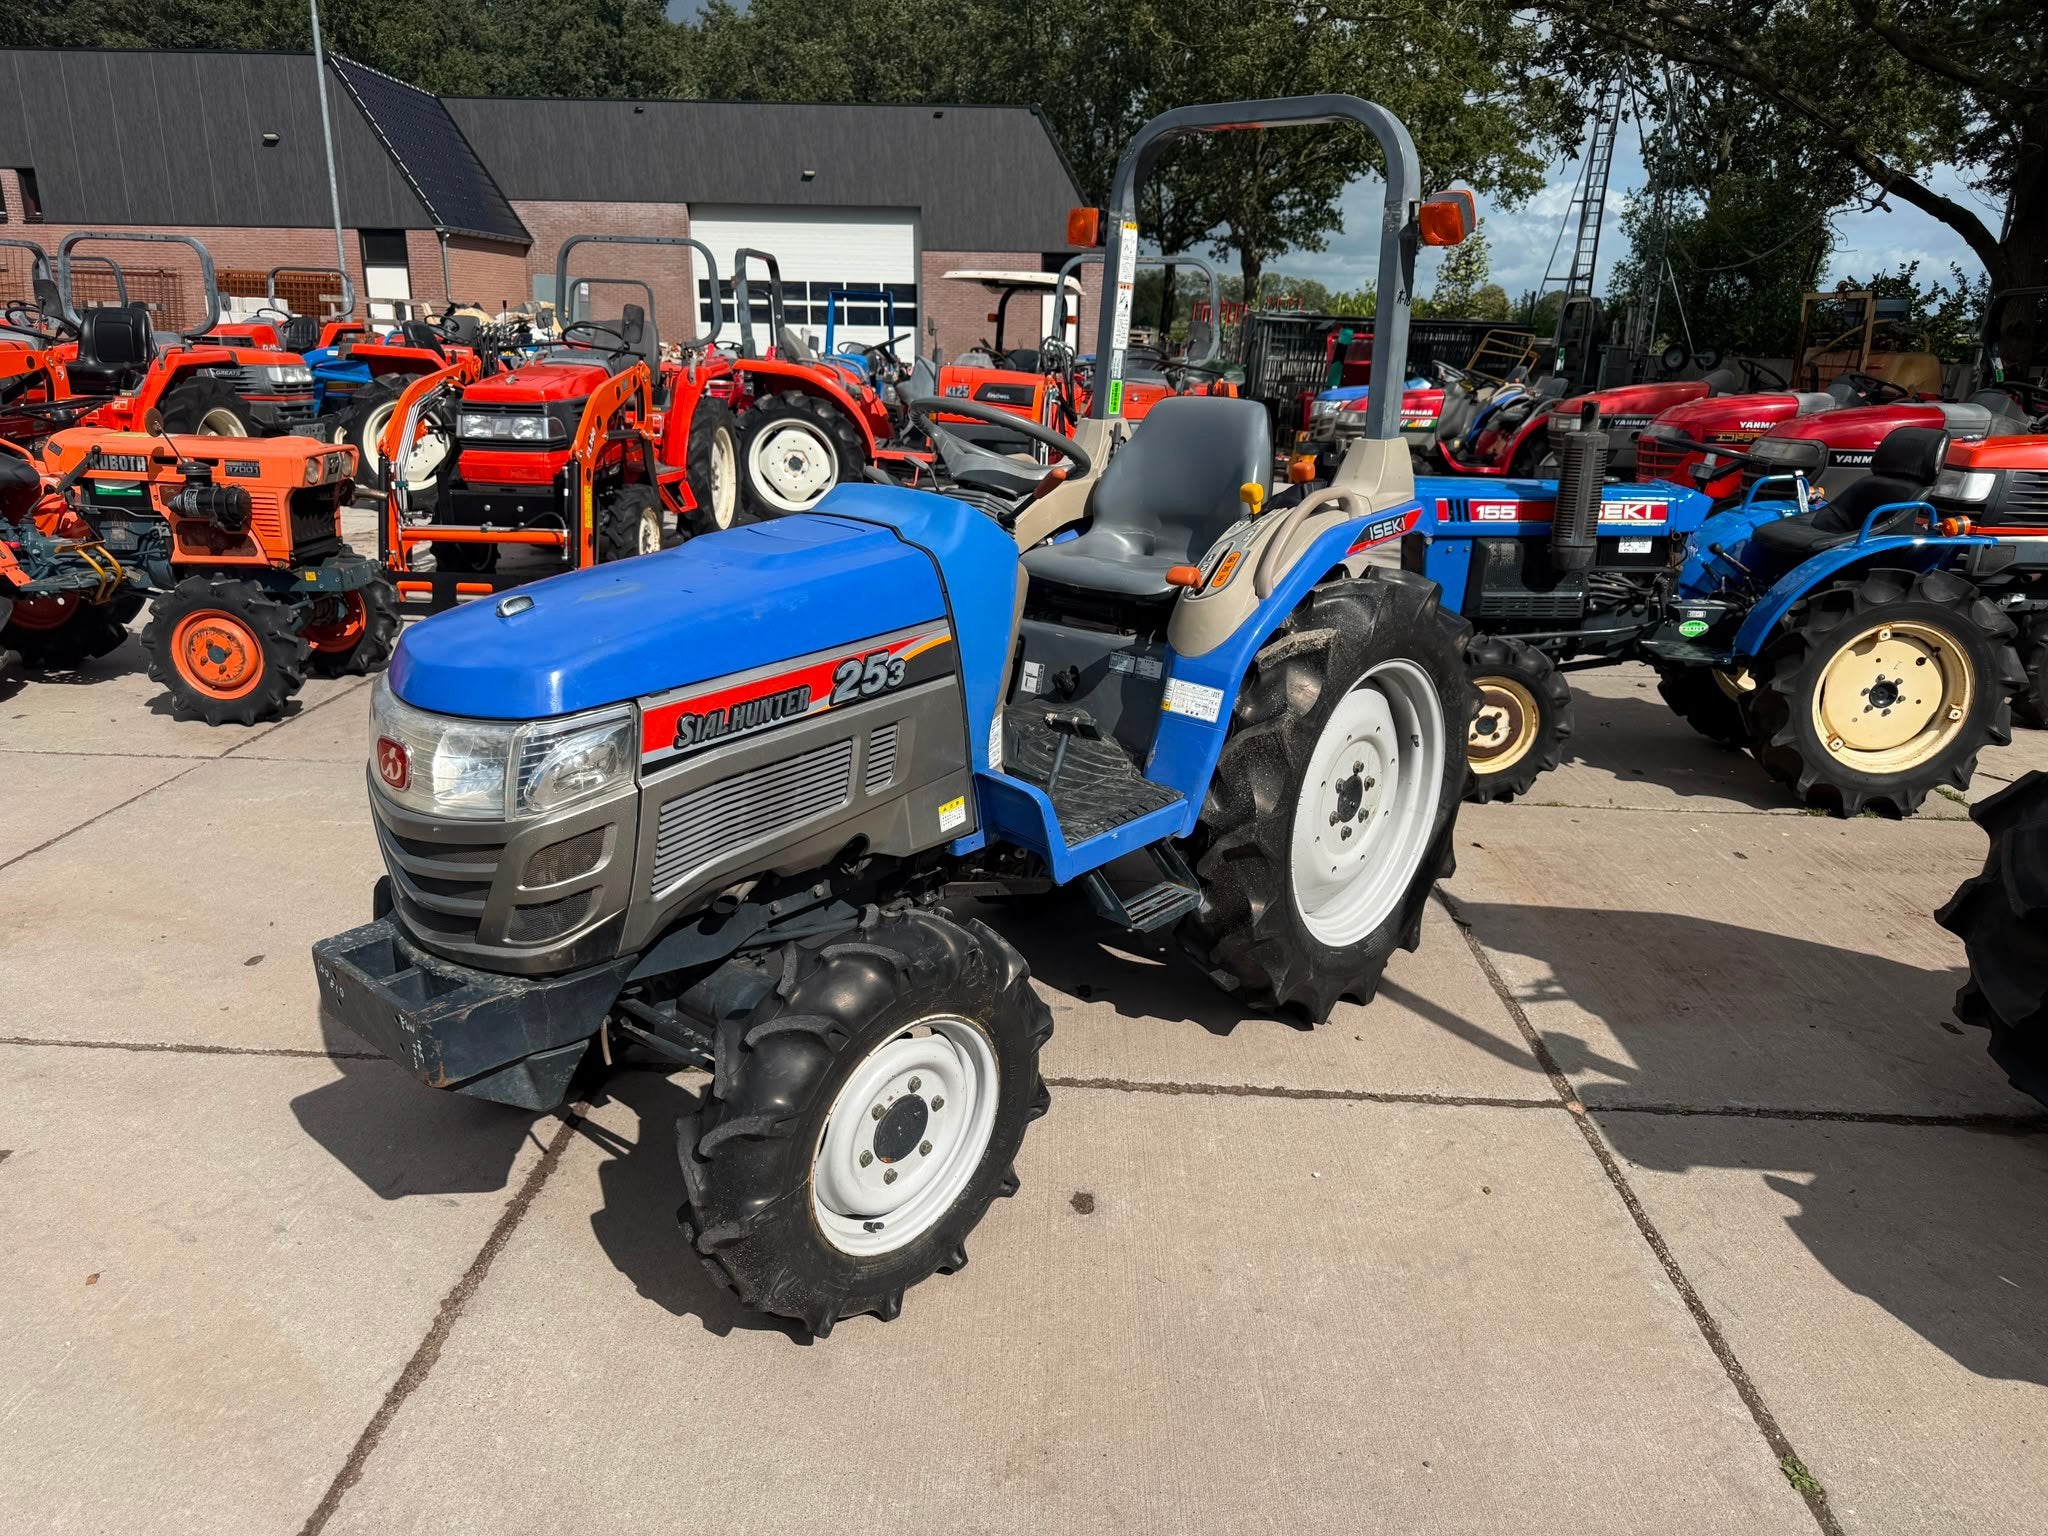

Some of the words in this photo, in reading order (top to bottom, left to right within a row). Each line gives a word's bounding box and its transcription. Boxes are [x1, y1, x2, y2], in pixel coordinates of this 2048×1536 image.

[1475, 504, 1517, 520] 155
[1369, 516, 1406, 541] ISEKI
[828, 650, 907, 706] 253
